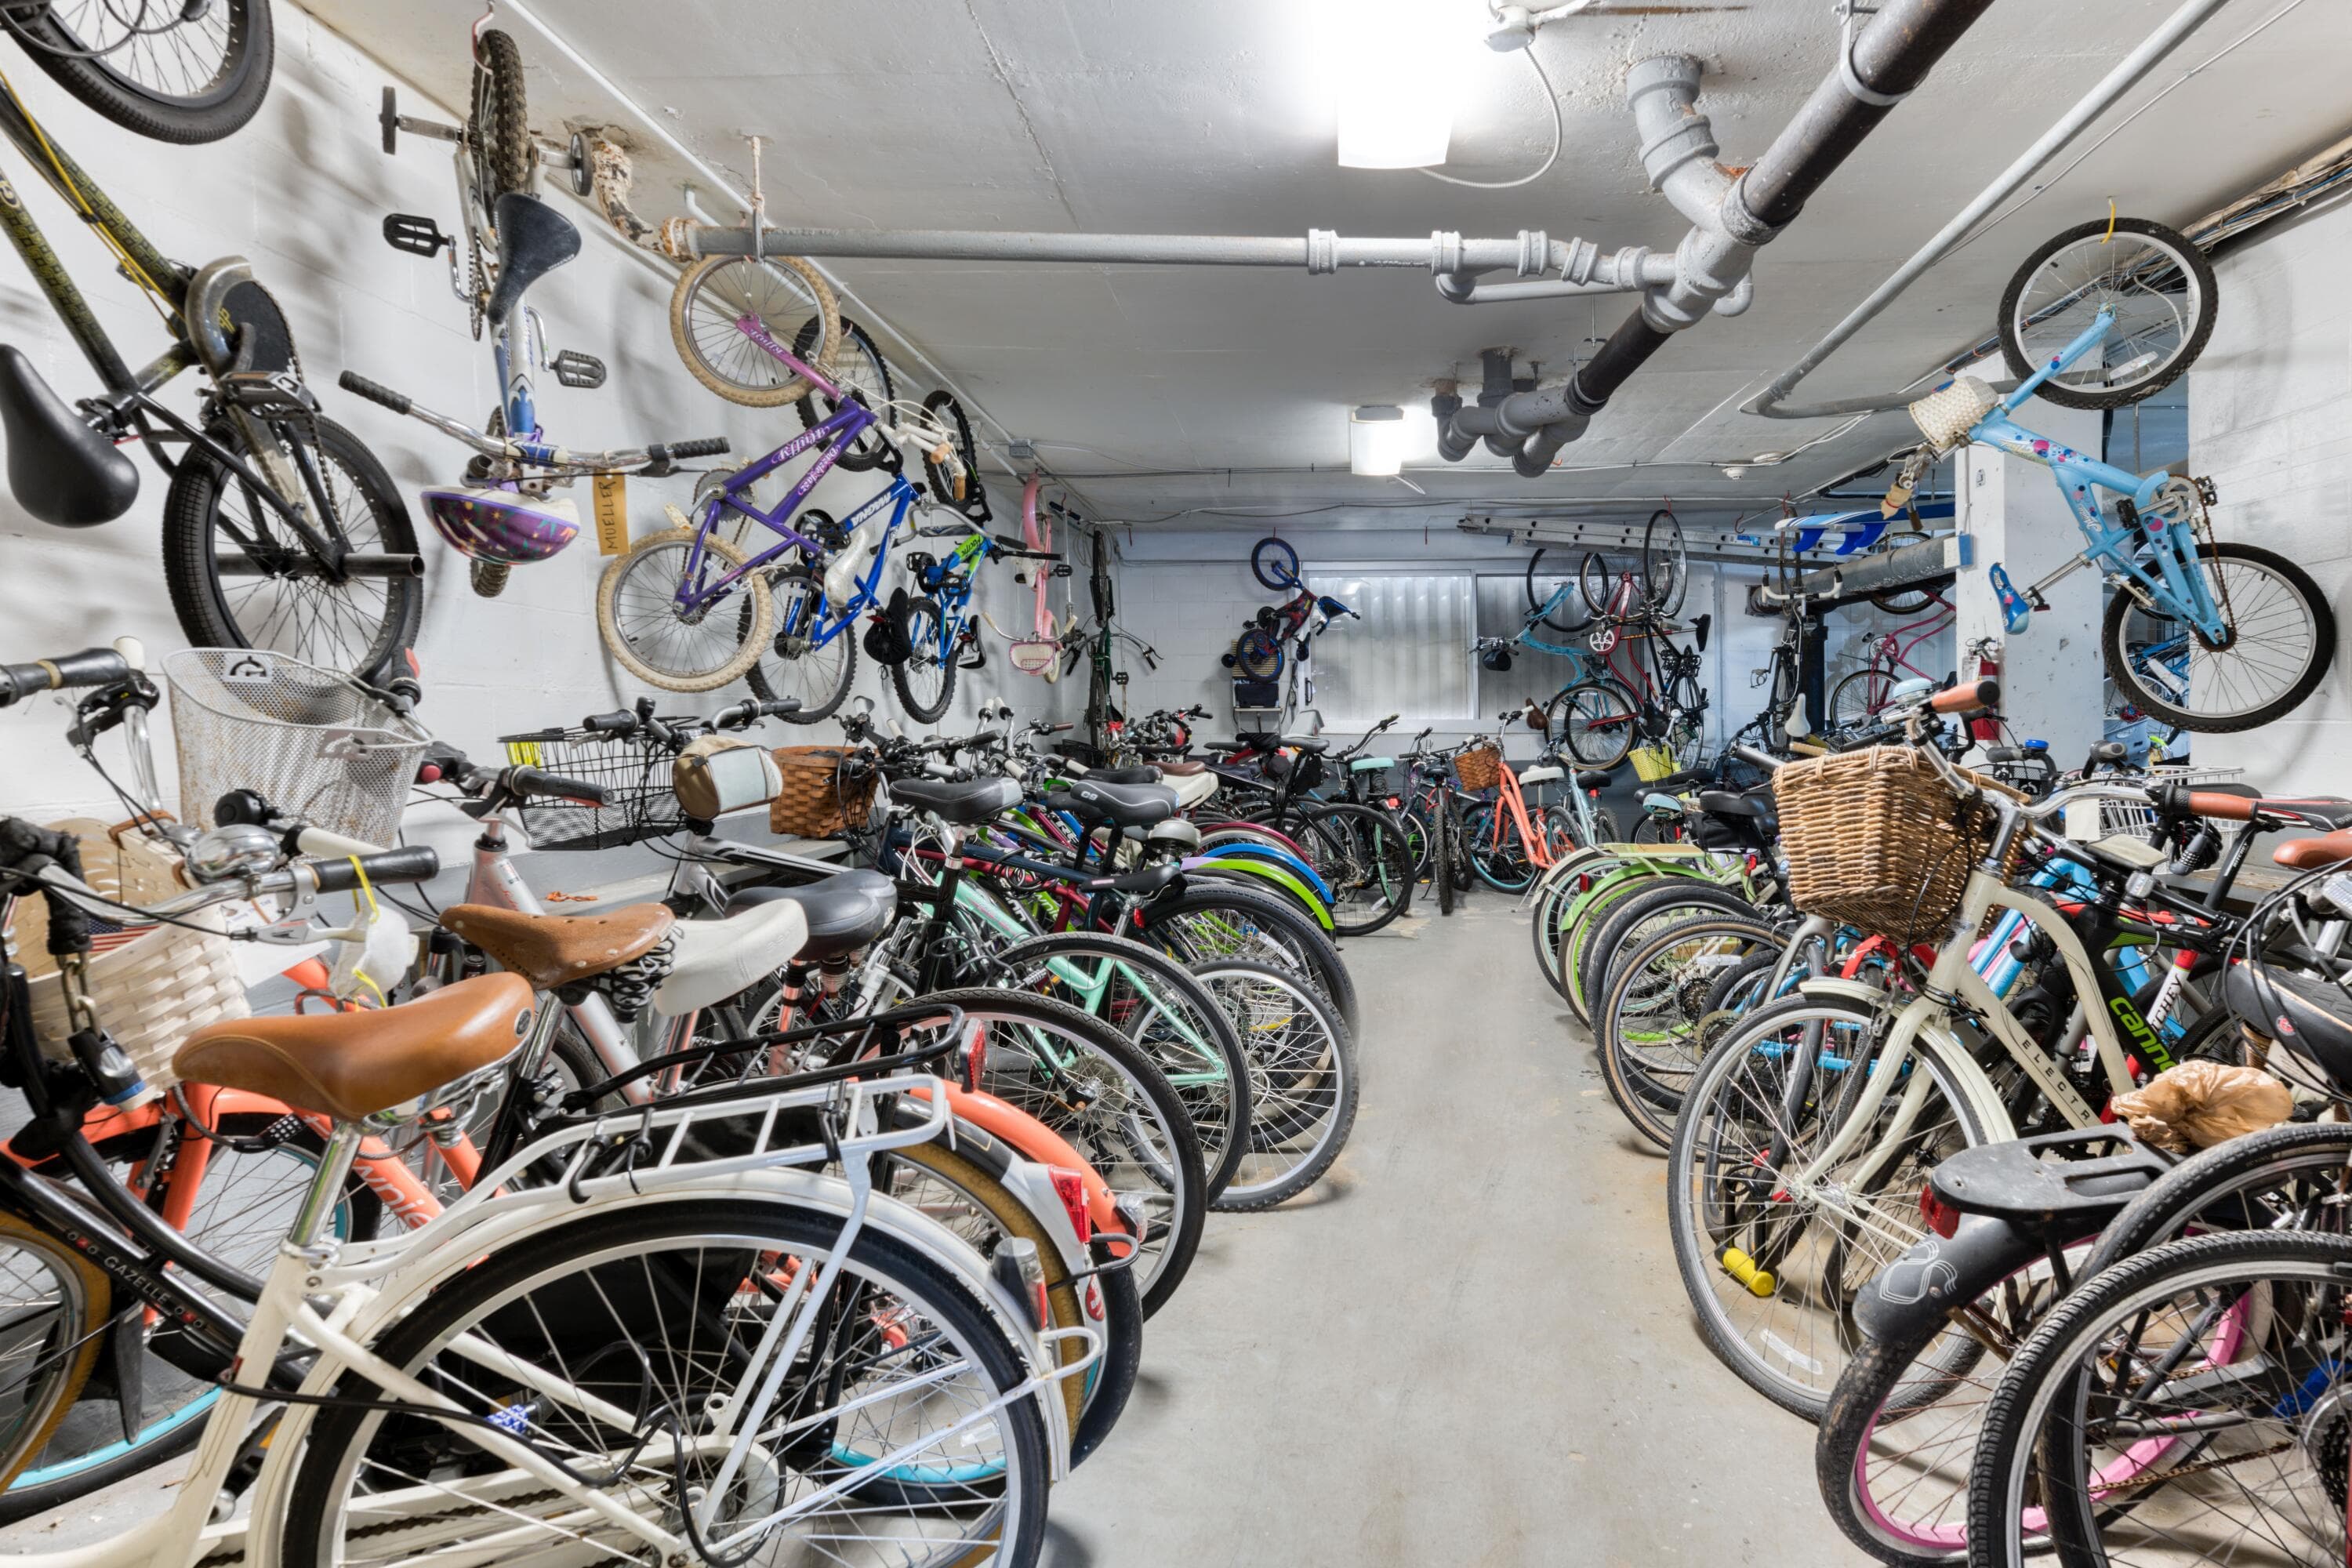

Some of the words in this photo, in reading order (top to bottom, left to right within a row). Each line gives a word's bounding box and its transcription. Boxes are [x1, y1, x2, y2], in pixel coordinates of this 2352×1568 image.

[771, 426, 830, 464] Huffy
[598, 480, 618, 550] MUELLER
[851, 492, 891, 526] MAGNA
[2022, 1039, 2092, 1121] ELECTR
[103, 1255, 172, 1304] GAZELLE
